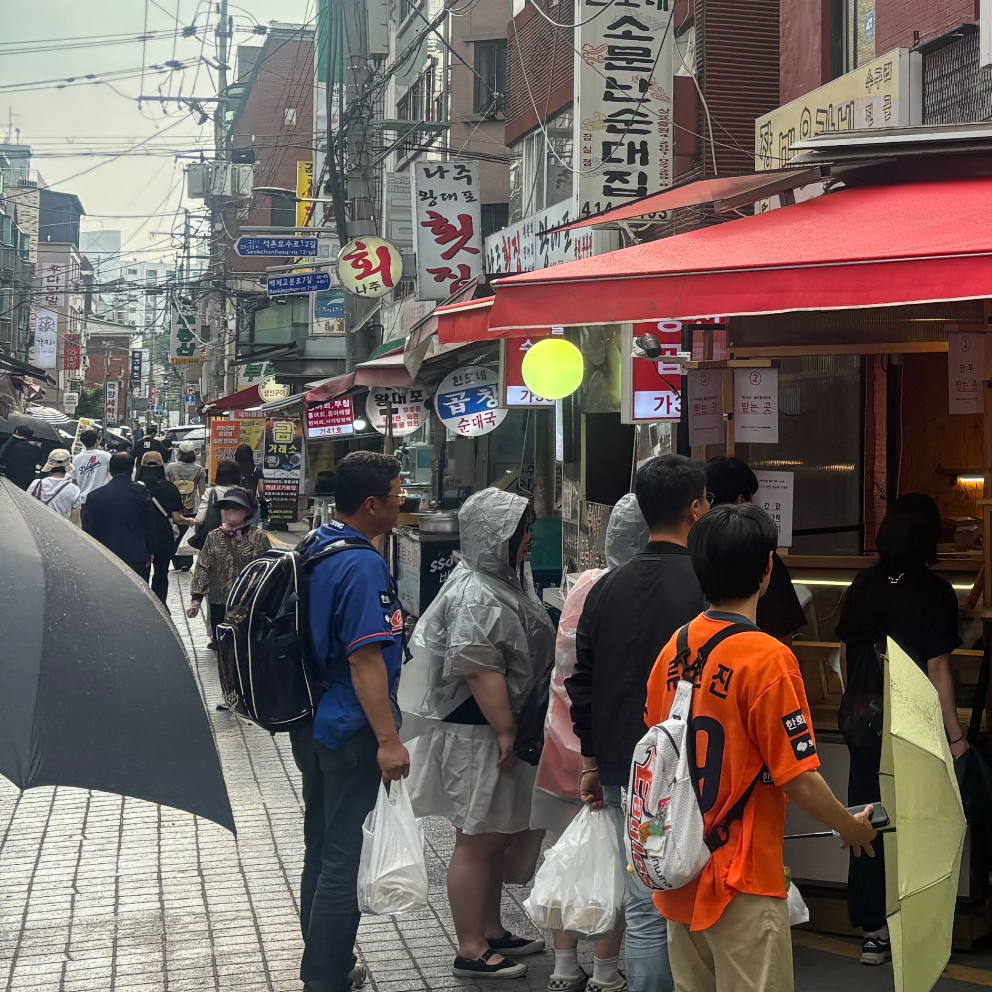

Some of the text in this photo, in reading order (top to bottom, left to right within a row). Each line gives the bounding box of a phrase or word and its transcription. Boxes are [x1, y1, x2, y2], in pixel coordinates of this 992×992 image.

[423, 165, 473, 185] 나주
[342, 241, 394, 288] 회
[355, 281, 381, 294] 나주
[442, 388, 499, 416] 곱창
[741, 401, 772, 413] 받는 곳
[457, 411, 497, 434] 순대국
